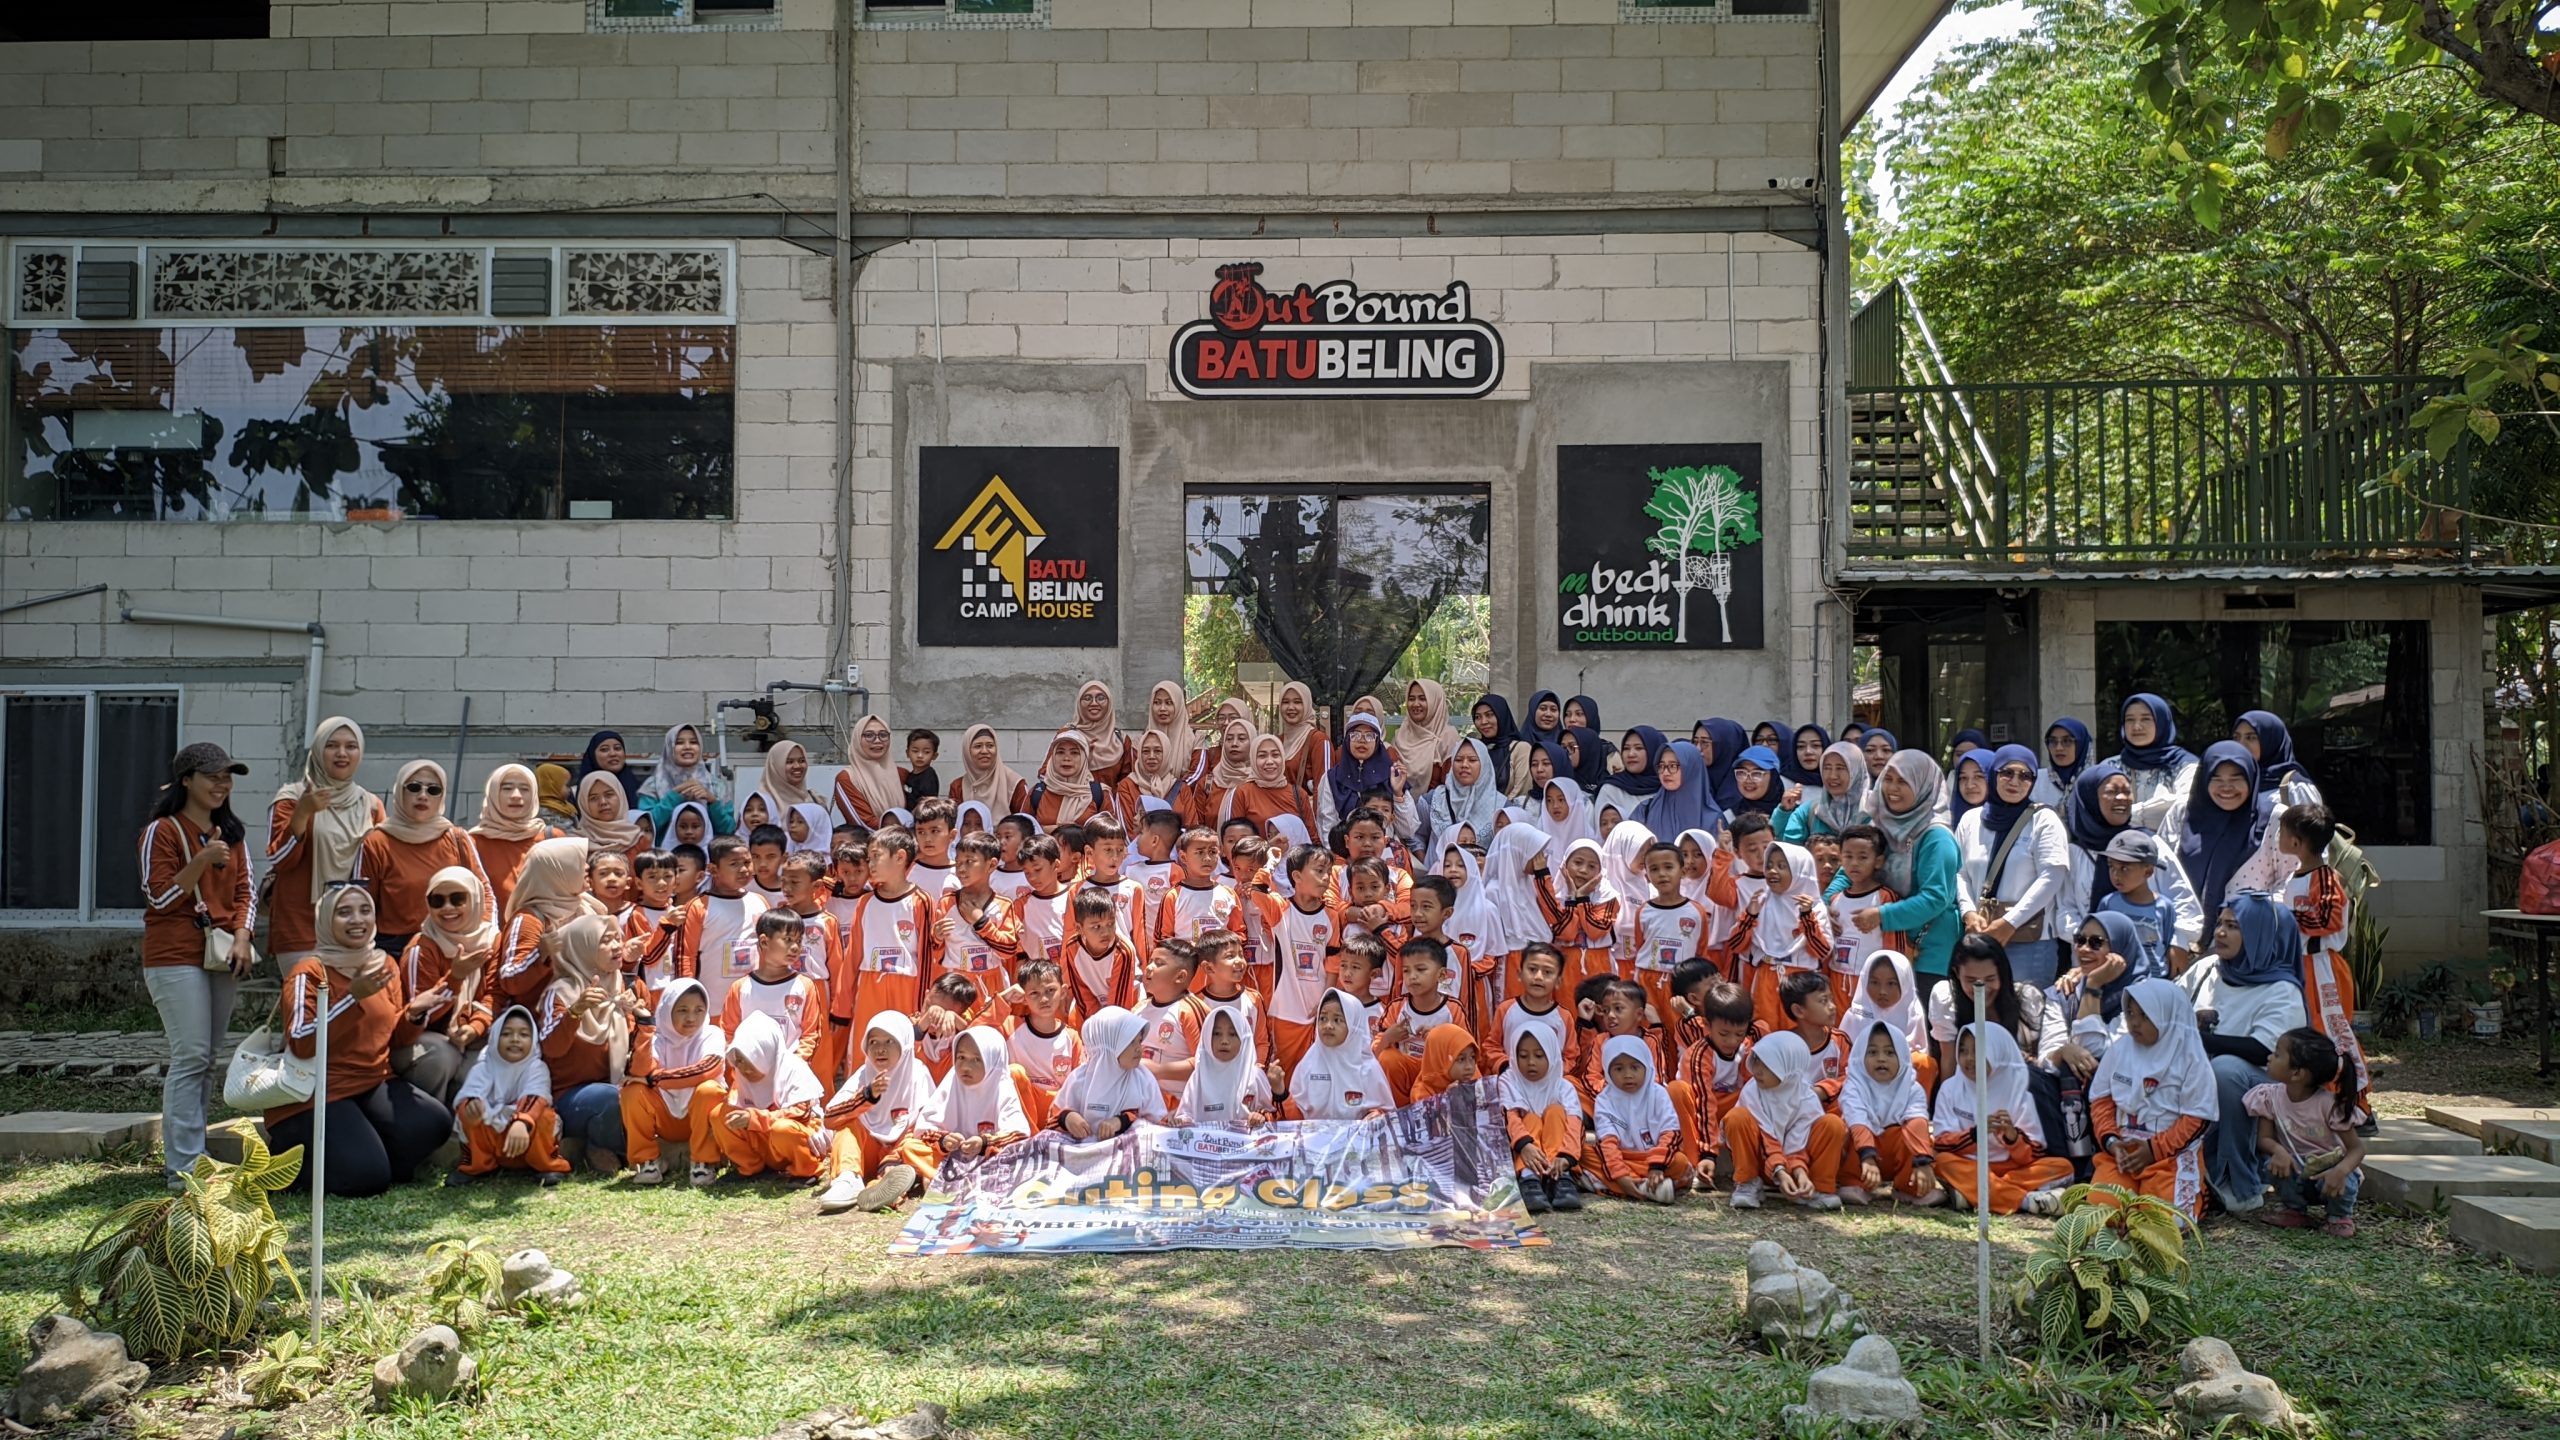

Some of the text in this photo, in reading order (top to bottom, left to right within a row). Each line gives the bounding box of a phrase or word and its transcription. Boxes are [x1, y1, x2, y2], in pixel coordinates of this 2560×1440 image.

[1315, 284, 1466, 323] Bound
[1029, 559, 1086, 579] BATU
[1028, 581, 1104, 602] BELING
[960, 602, 1095, 618] CAMP HOUSE
[1563, 593, 1671, 628] dhink
[1575, 627, 1674, 642] outbound
[1257, 1177, 1431, 1211] Class
